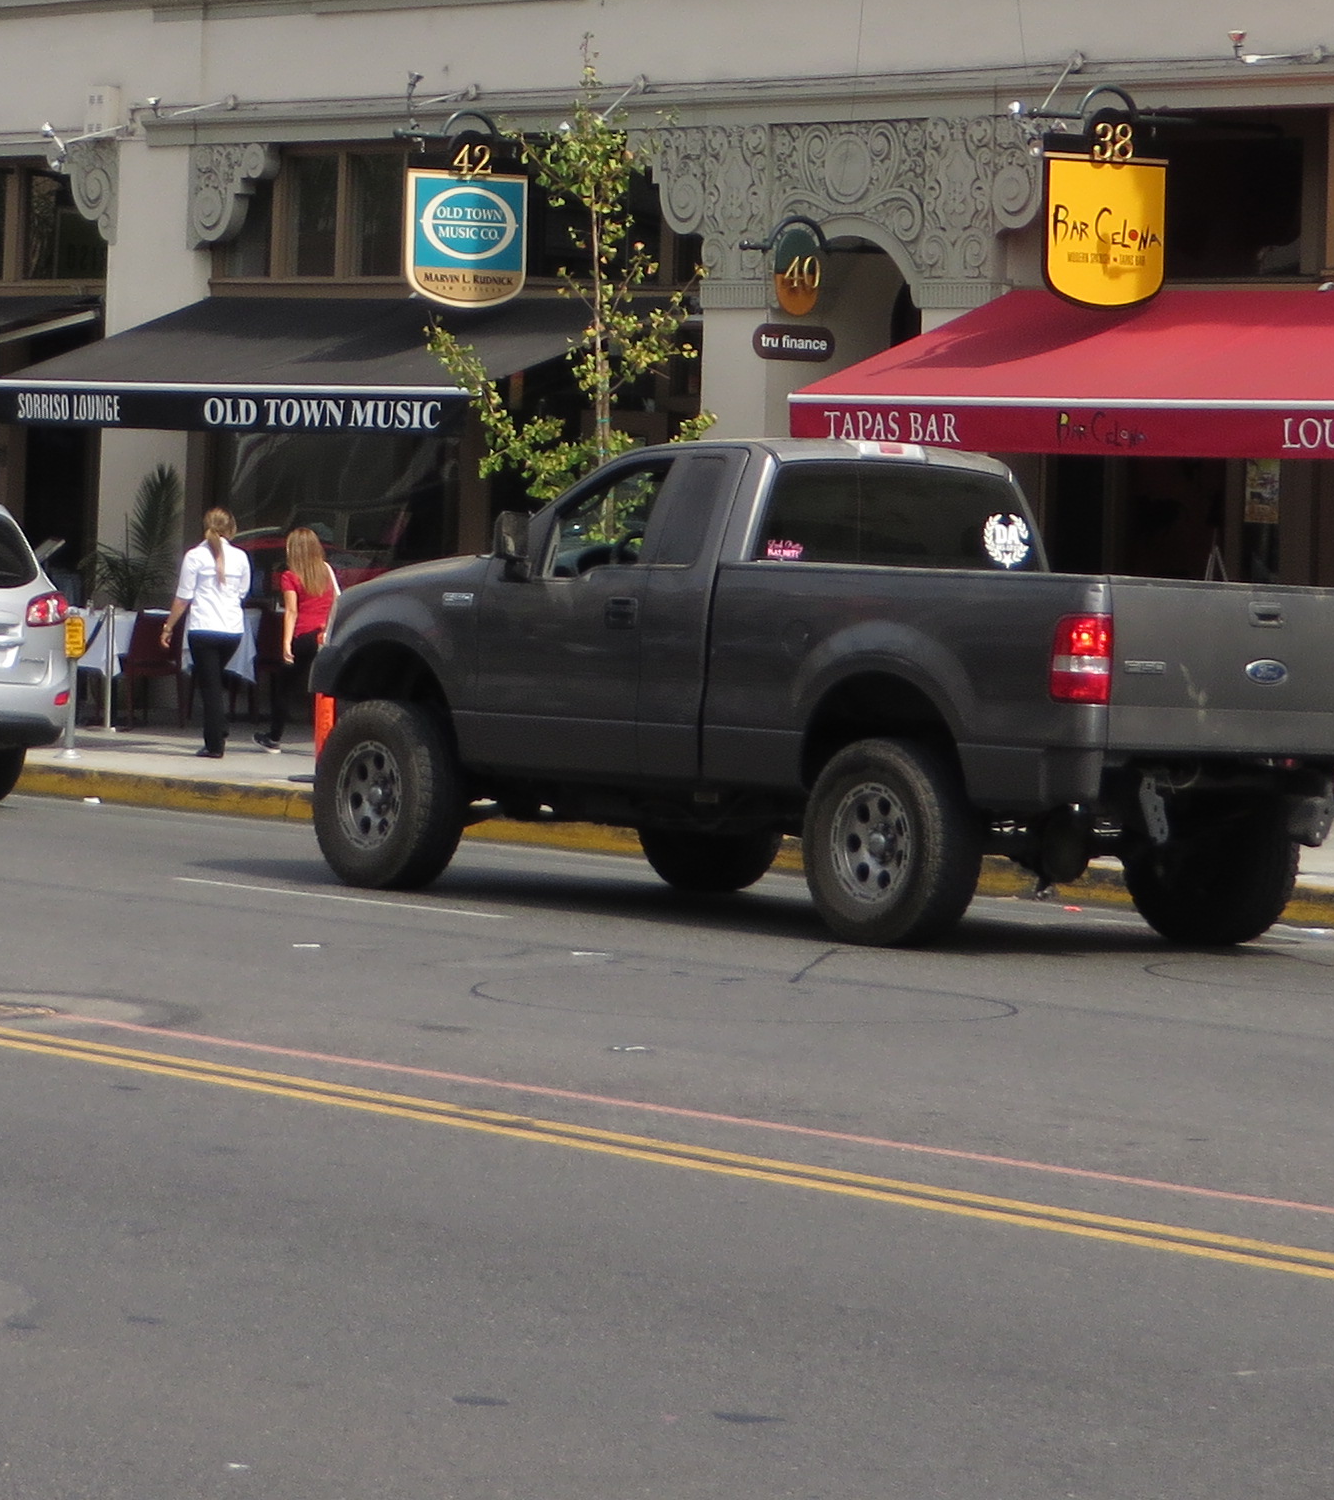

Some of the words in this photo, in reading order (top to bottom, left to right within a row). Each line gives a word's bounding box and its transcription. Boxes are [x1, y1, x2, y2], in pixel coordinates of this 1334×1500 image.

[1092, 122, 1134, 160] 38
[453, 143, 492, 175] 42
[436, 206, 463, 220] OLD
[465, 207, 503, 221] TOWN
[438, 225, 479, 240] MUSIC
[480, 227, 500, 241] CO.
[423, 271, 460, 283] MARVIN
[473, 274, 514, 286] RUDNICK
[784, 255, 821, 288] 40
[761, 334, 779, 348] tru
[782, 335, 827, 351] finance
[17, 392, 69, 421] SORRISO
[73, 394, 121, 422] LOUNGE
[203, 396, 257, 426] OLD
[264, 399, 345, 428] TOWN
[348, 399, 442, 430] MUSIC
[823, 411, 901, 441] TAPAS
[909, 411, 961, 443] BAR
[995, 523, 1020, 545] DA
